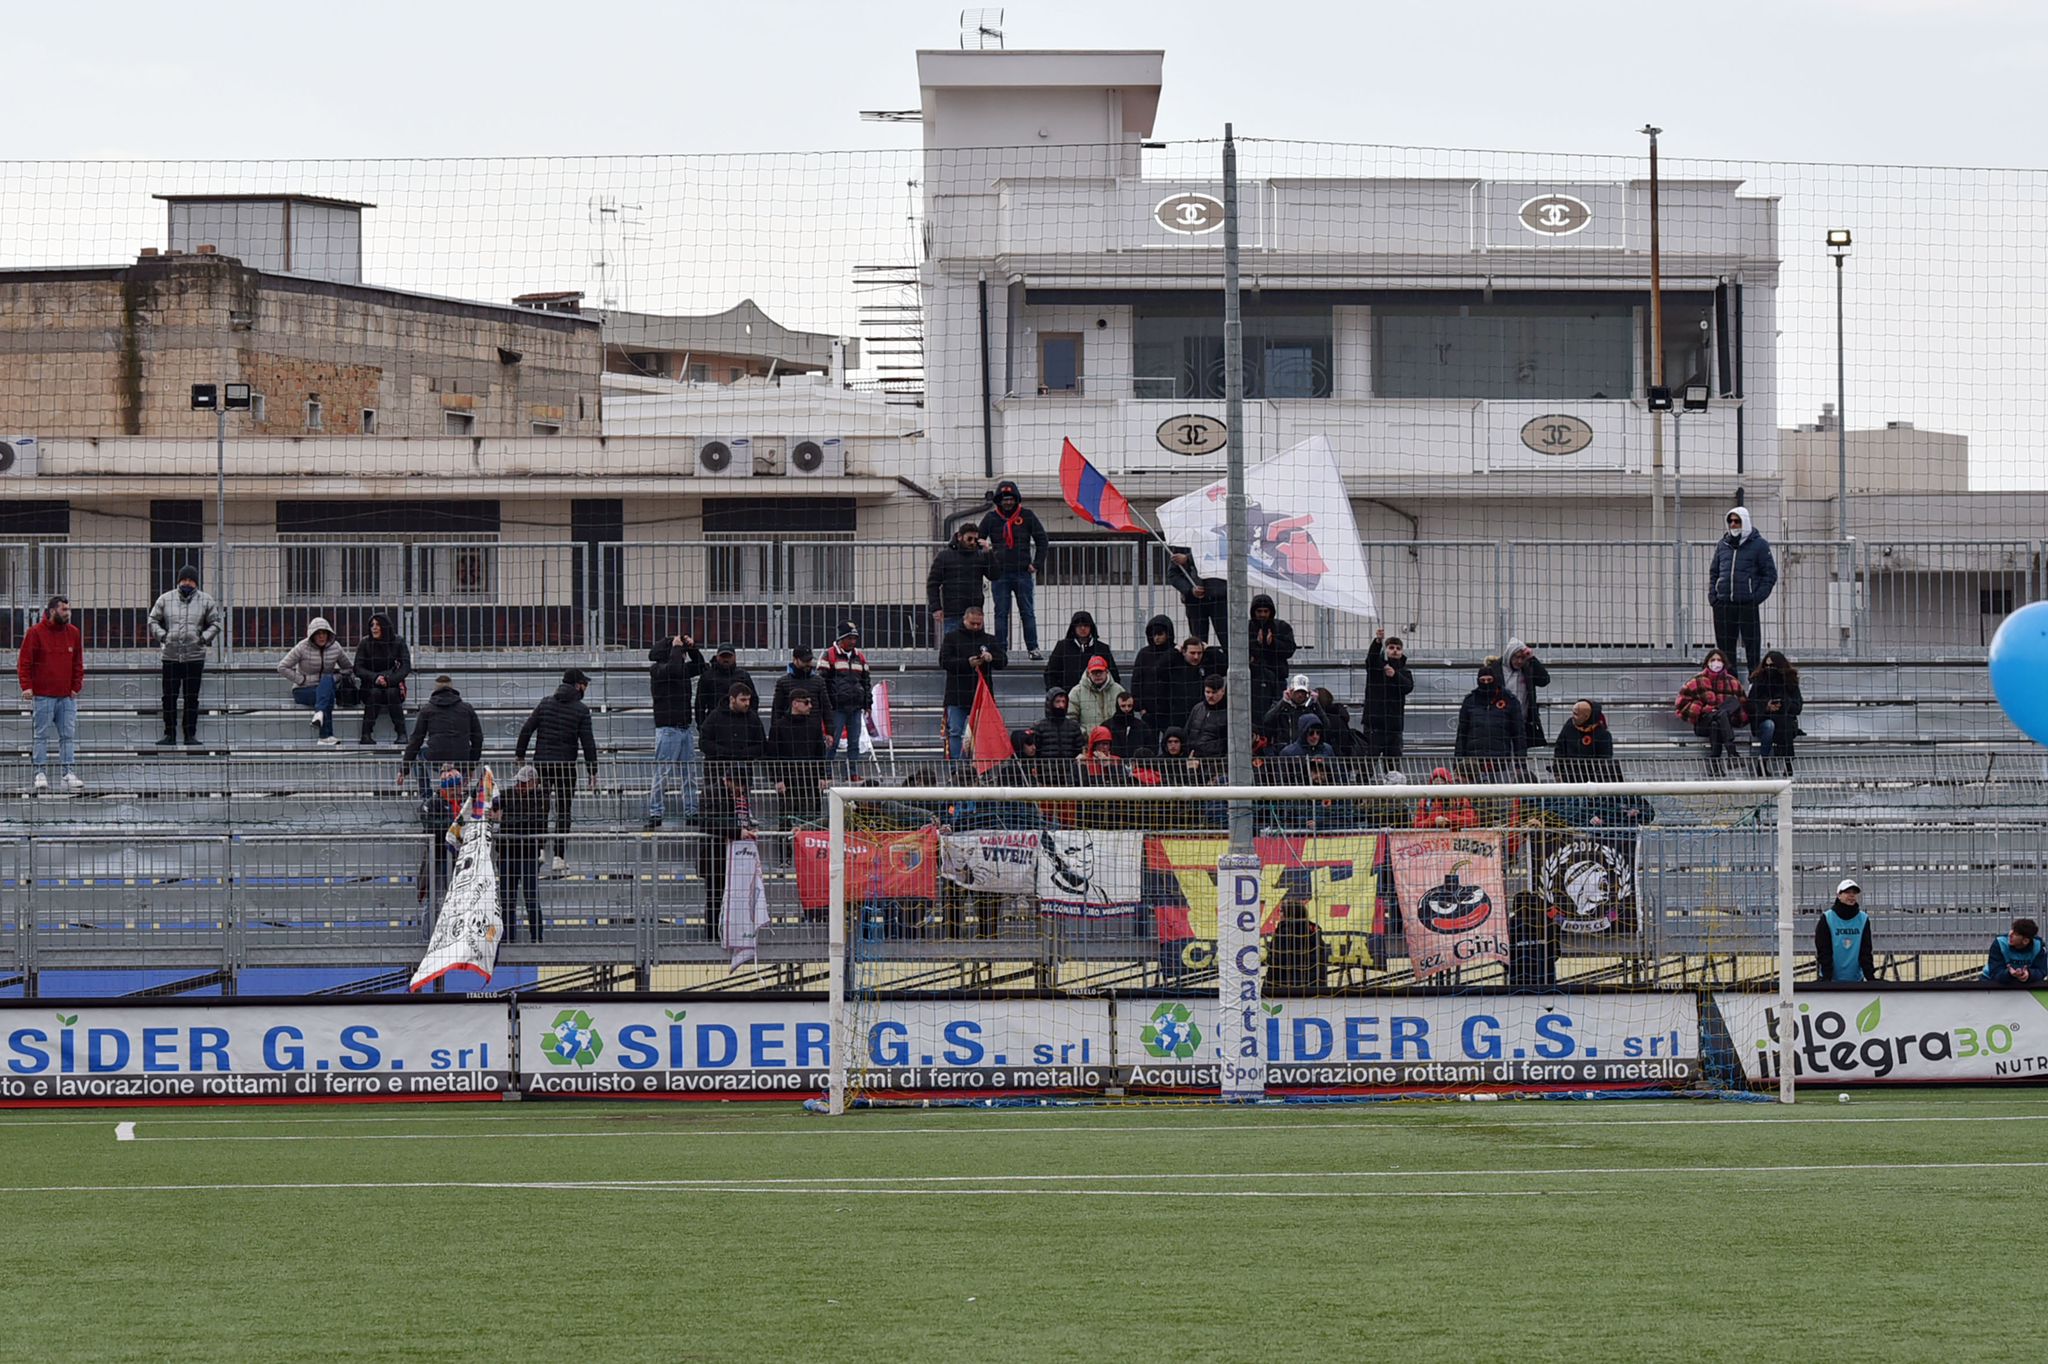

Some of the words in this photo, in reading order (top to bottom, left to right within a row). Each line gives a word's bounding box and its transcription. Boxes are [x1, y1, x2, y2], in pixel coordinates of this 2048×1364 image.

[1572, 841, 1600, 853] 2017
[1453, 935, 1509, 960] Girls
[1215, 1016, 1432, 1061] IDER
[1461, 1015, 1597, 1059] G.S.
[1623, 1031, 1678, 1057] srl
[1765, 1003, 1846, 1047] bio
[263, 1025, 403, 1070] G.S.
[431, 1043, 488, 1069] srl
[868, 1020, 1006, 1066] G.S.
[1033, 1039, 1089, 1064] srl
[33, 1080, 48, 1096] e
[56, 1075, 194, 1096] lavorazione
[203, 1073, 287, 1095] rottami
[295, 1073, 316, 1093] di
[324, 1072, 381, 1093] ferro
[389, 1076, 402, 1092] e
[411, 1071, 498, 1092] metallo
[529, 1072, 636, 1093] Acquisto
[643, 1075, 657, 1090] e
[665, 1071, 801, 1092] lavorazione
[900, 1068, 920, 1088] di
[928, 1068, 984, 1088] ferro
[992, 1072, 1006, 1087] e
[1014, 1067, 1100, 1087] metallo
[1129, 1064, 1221, 1087] Acquist
[1263, 1063, 1396, 1084] lavorazione
[1404, 1061, 1485, 1082] rottami
[1493, 1061, 1514, 1081] di
[1522, 1061, 1575, 1081] ferro
[1583, 1065, 1597, 1080] e
[1604, 1061, 1688, 1080] metallo
